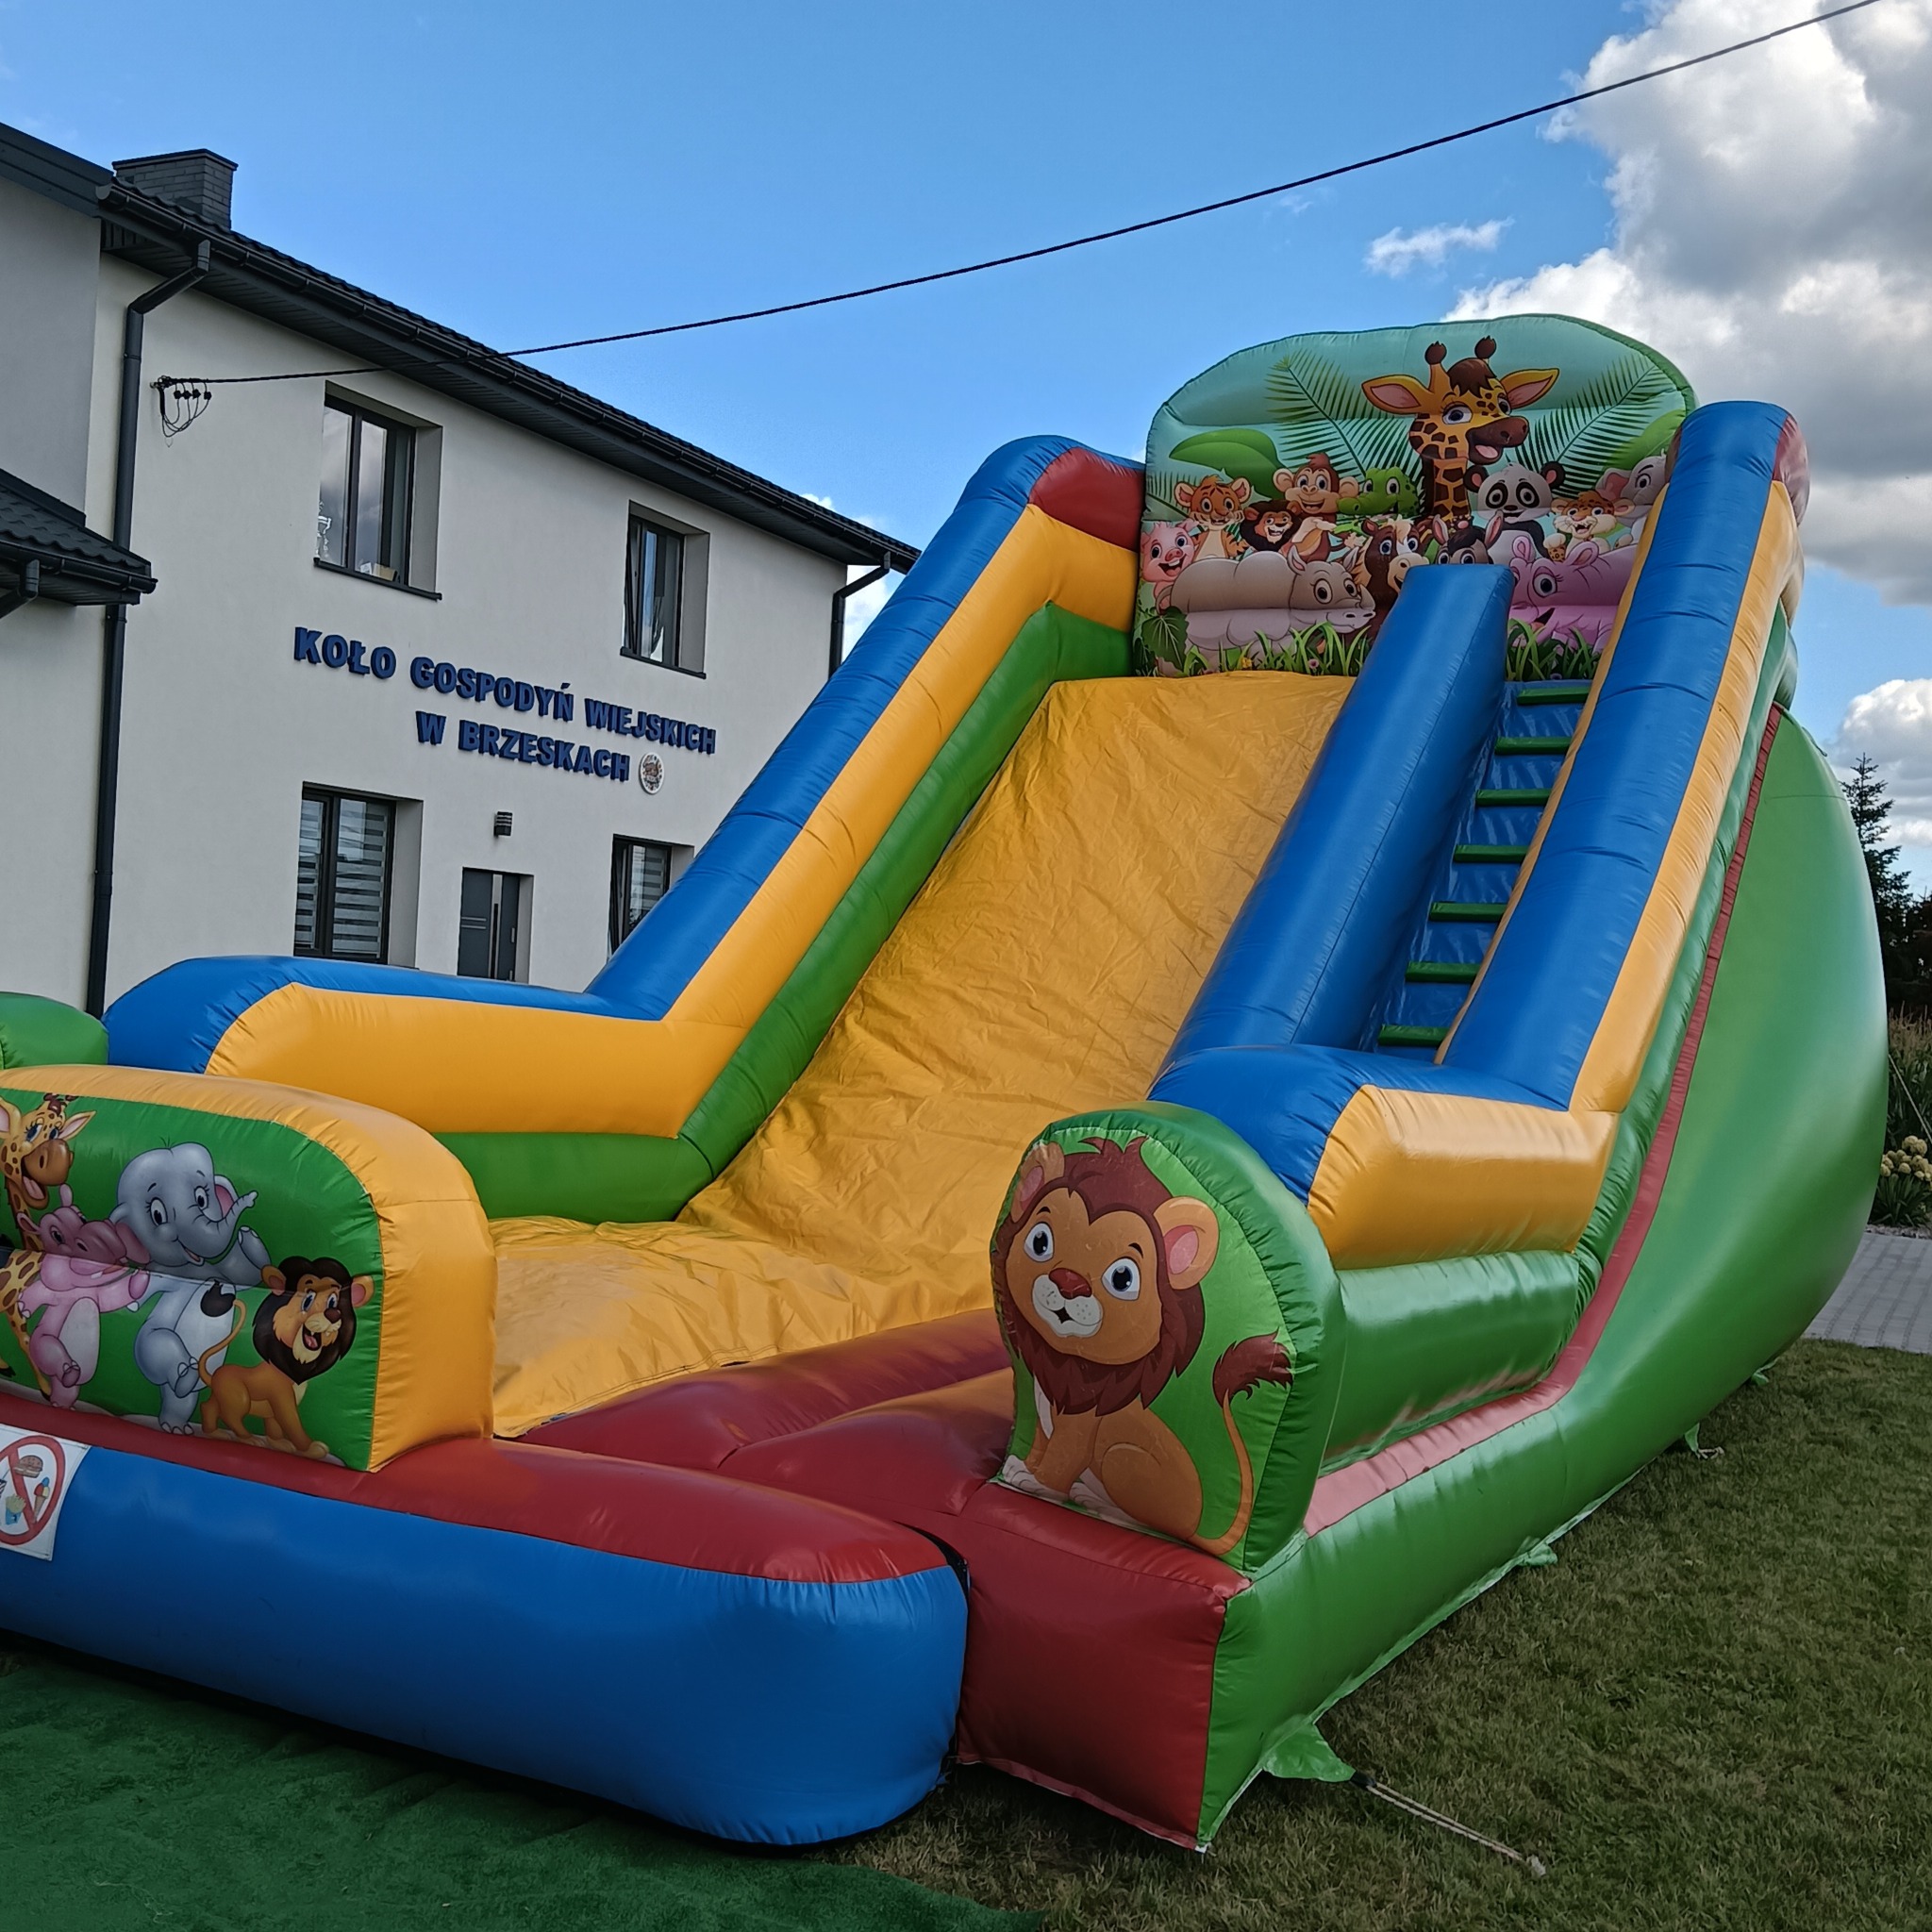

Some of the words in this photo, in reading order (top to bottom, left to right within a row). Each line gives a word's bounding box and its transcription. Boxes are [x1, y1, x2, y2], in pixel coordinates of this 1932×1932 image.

[294, 627, 396, 679] KOŁO
[410, 657, 574, 722] GOSPODYŃ
[585, 699, 716, 755] WIEJSKICH
[416, 711, 446, 745] W
[458, 720, 629, 782] BRZESKACH
